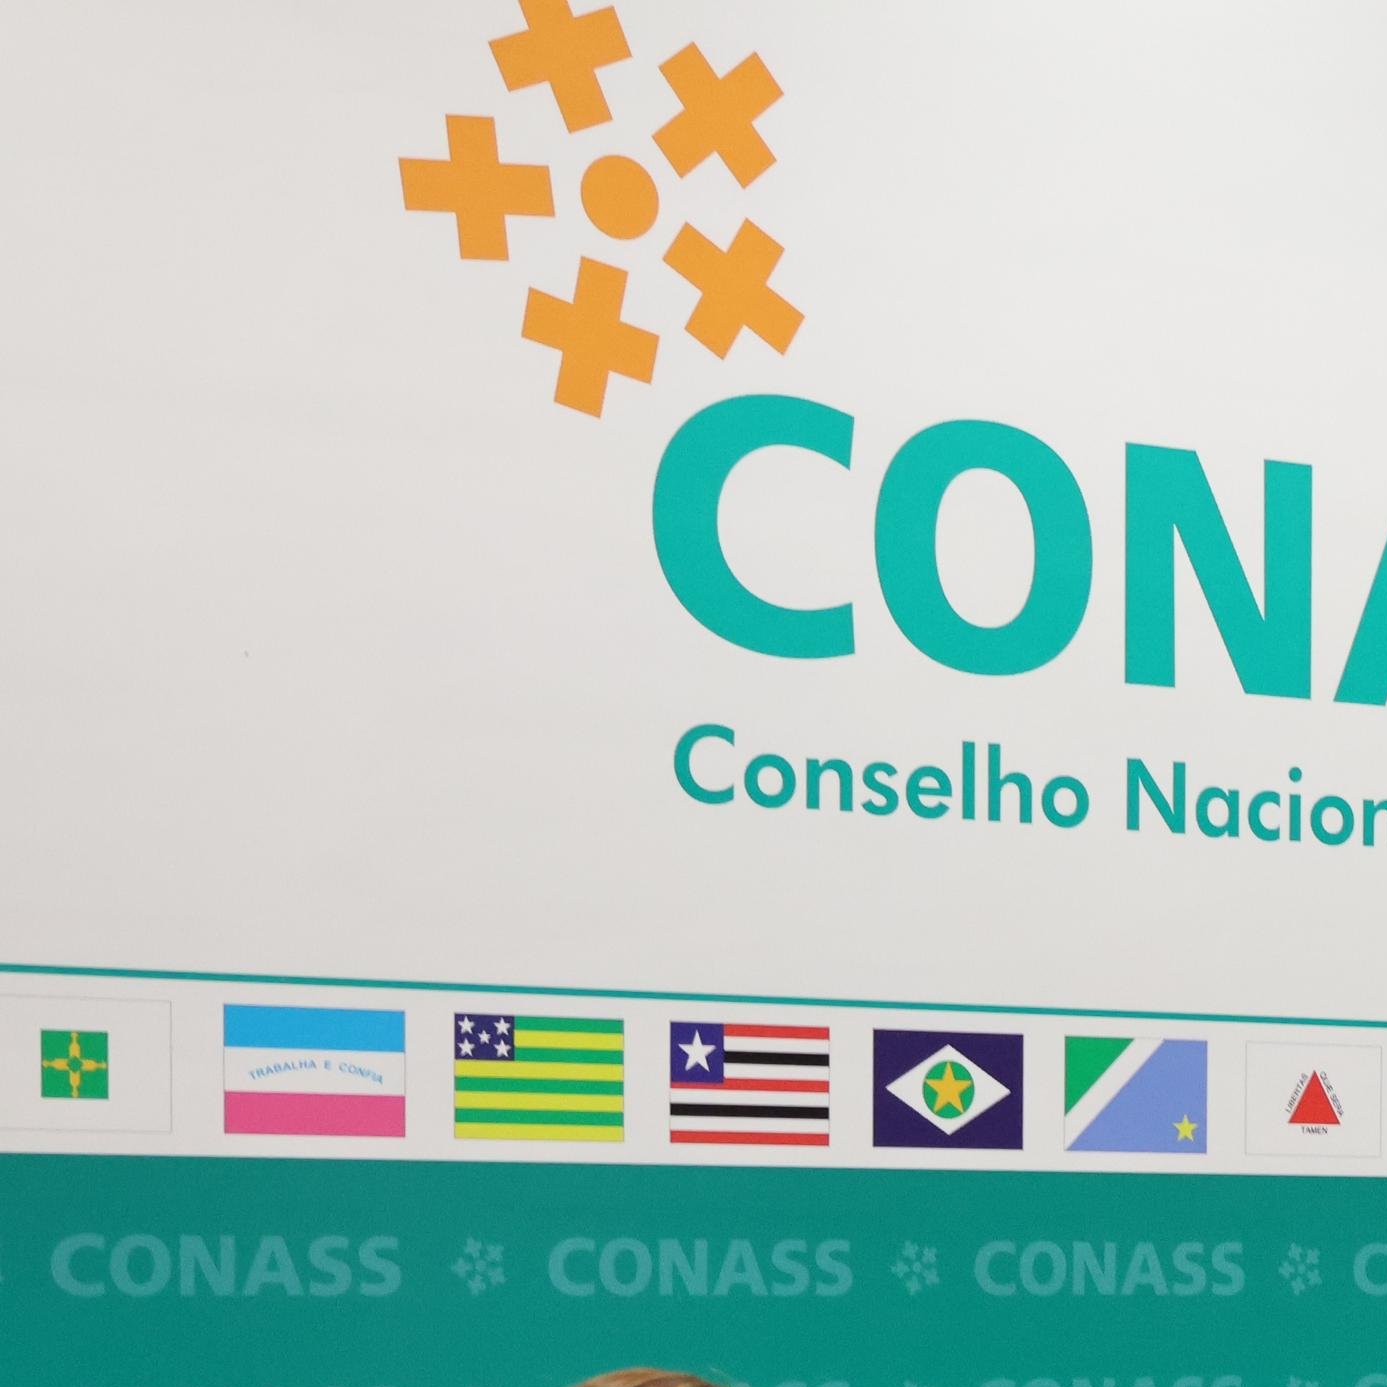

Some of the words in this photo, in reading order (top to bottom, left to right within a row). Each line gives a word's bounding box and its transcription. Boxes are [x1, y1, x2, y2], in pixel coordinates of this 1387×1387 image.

[673, 723, 1090, 829] Conselho
[249, 1059, 317, 1081] TRABALHA
[323, 1060, 332, 1070] E
[339, 1062, 384, 1085] CONFIA
[50, 1234, 401, 1296] CONASS
[549, 1237, 852, 1297] CONASS
[973, 1241, 1246, 1297] CONASS
